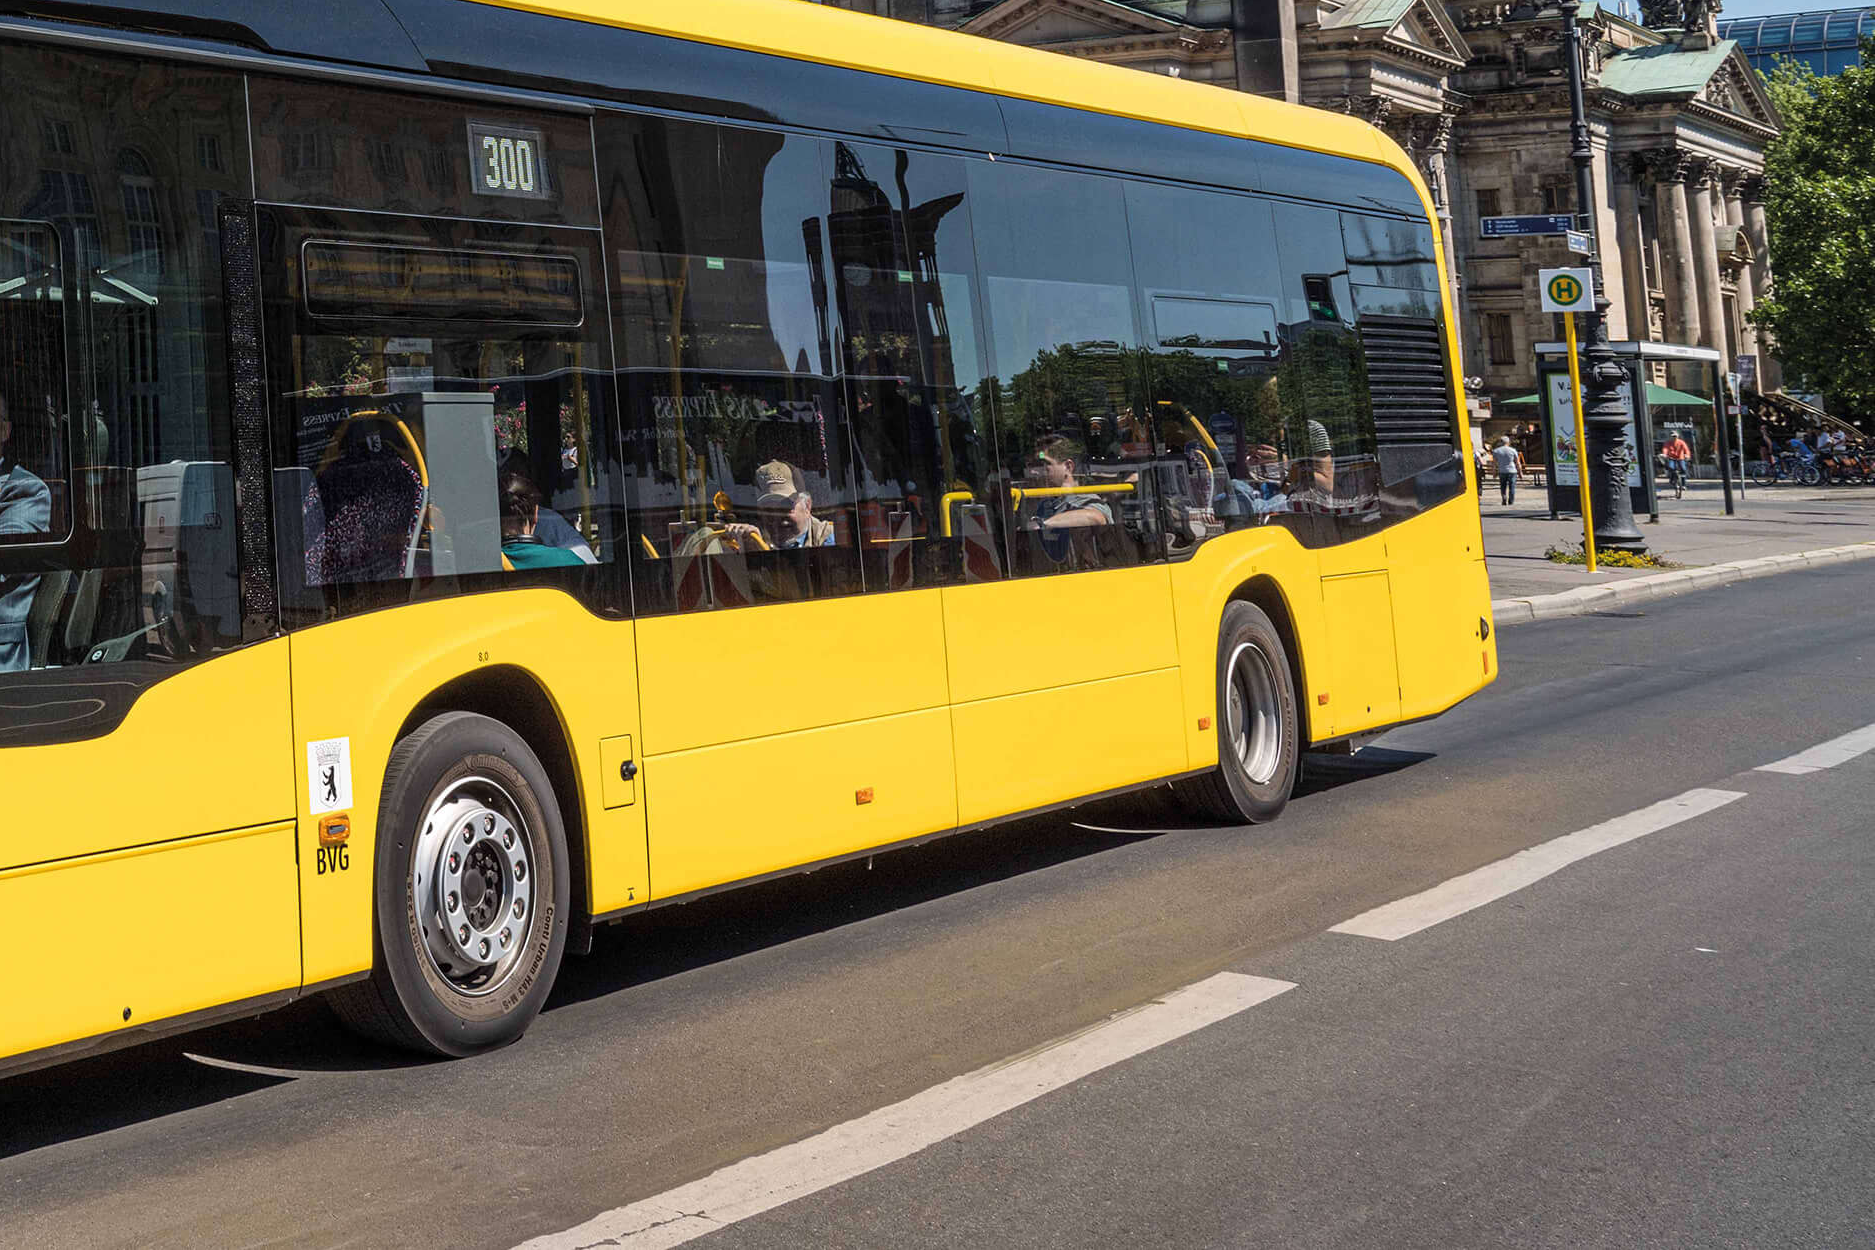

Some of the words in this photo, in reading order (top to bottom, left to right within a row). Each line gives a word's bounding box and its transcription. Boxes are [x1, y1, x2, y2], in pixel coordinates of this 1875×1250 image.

[484, 136, 533, 191] 300
[1556, 281, 1574, 299] H
[316, 843, 350, 875] BVG
[541, 907, 554, 940] Conti
[530, 942, 547, 975] Urban
